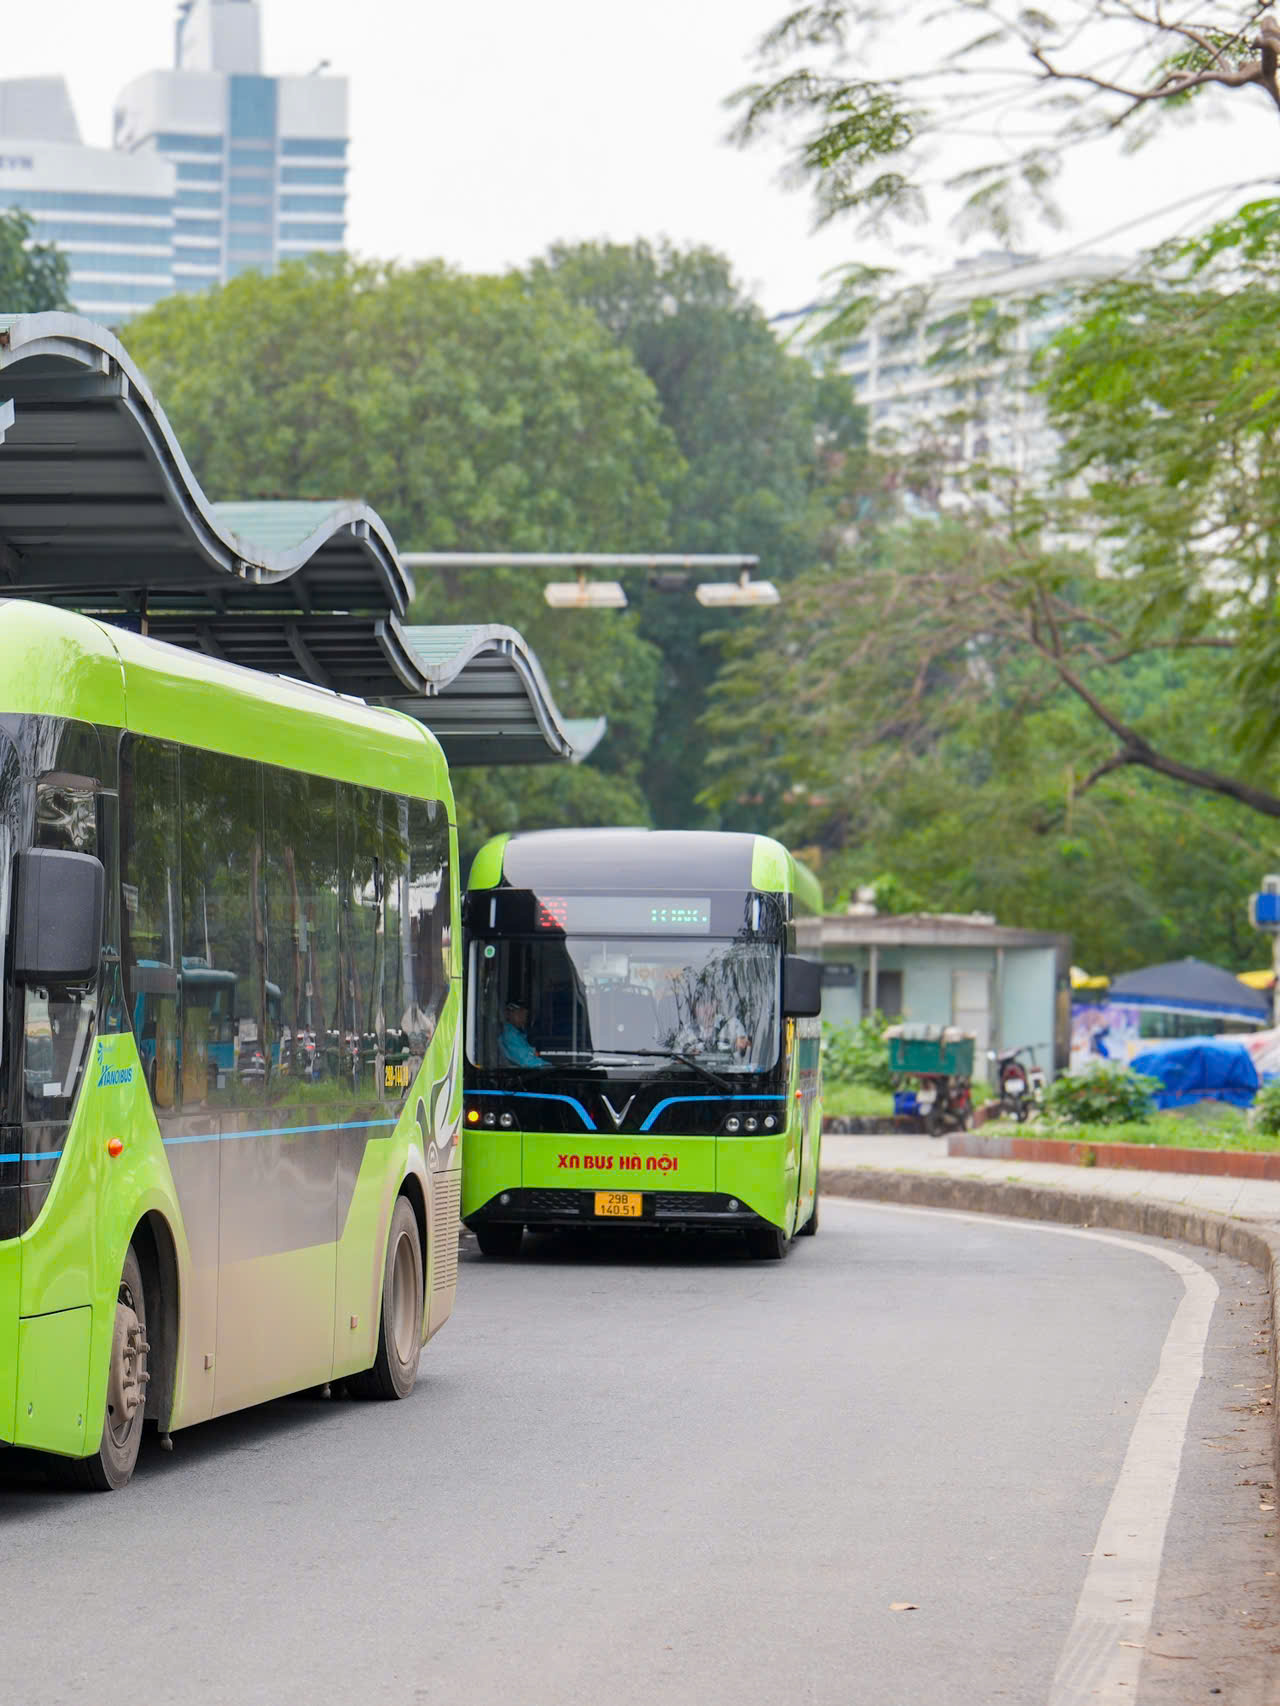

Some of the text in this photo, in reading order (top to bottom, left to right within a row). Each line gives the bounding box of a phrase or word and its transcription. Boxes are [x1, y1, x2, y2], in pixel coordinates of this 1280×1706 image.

[557, 1153, 679, 1176] XN BUS HÀ NỘI
[608, 1194, 629, 1205] 29B
